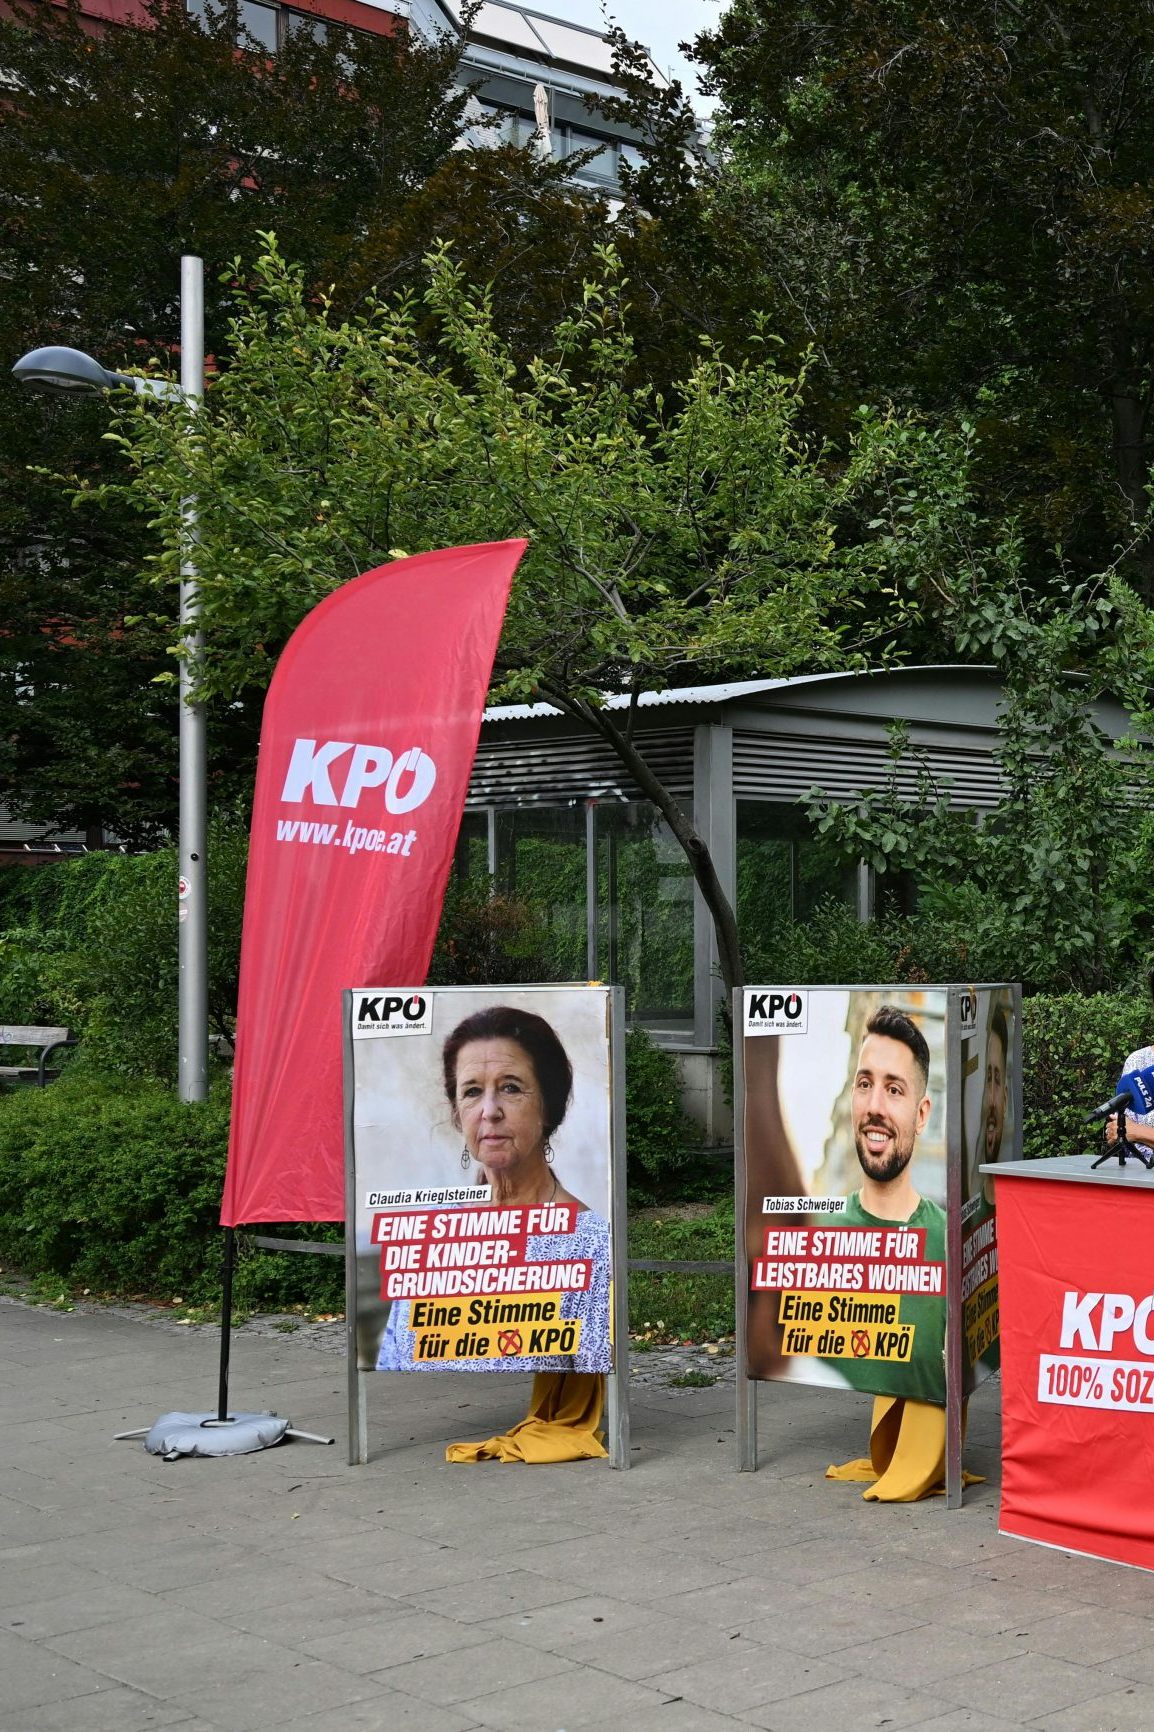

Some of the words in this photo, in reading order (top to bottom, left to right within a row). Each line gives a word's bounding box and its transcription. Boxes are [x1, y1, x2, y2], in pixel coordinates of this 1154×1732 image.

[276, 820, 417, 857] www.kpoe.at
[748, 1020, 763, 1028] Damit
[1134, 1076, 1149, 1097] PULS
[1145, 1096, 1153, 1108] 24
[369, 1192, 412, 1205] Claudia
[415, 1189, 488, 1204] Krieglsteiner
[765, 1199, 795, 1211] Tobias
[796, 1199, 845, 1213] Schweiger
[377, 1215, 428, 1242] EINE
[431, 1209, 522, 1239] STIMME
[526, 1202, 570, 1233] FÜR
[385, 1244, 422, 1271] DIE
[426, 1240, 518, 1268] KINDER-
[767, 1231, 808, 1256] EINE
[811, 1231, 883, 1257] STIMME
[884, 1226, 920, 1259] FÜR
[387, 1263, 587, 1298] GRUNDSICHERUNG
[755, 1262, 864, 1290] LEISTBARES
[868, 1264, 942, 1292] WOHNEN
[412, 1302, 462, 1328] Eine
[467, 1299, 556, 1326] Stimme
[782, 1295, 823, 1322] Eine
[828, 1295, 896, 1325] Stimme
[418, 1333, 449, 1359] für
[460, 1332, 490, 1357] die
[528, 1321, 576, 1353] KPÖ
[786, 1328, 814, 1354] für
[817, 1330, 845, 1354] die
[874, 1326, 911, 1359] KPÖ
[1047, 1363, 1103, 1400] 100%
